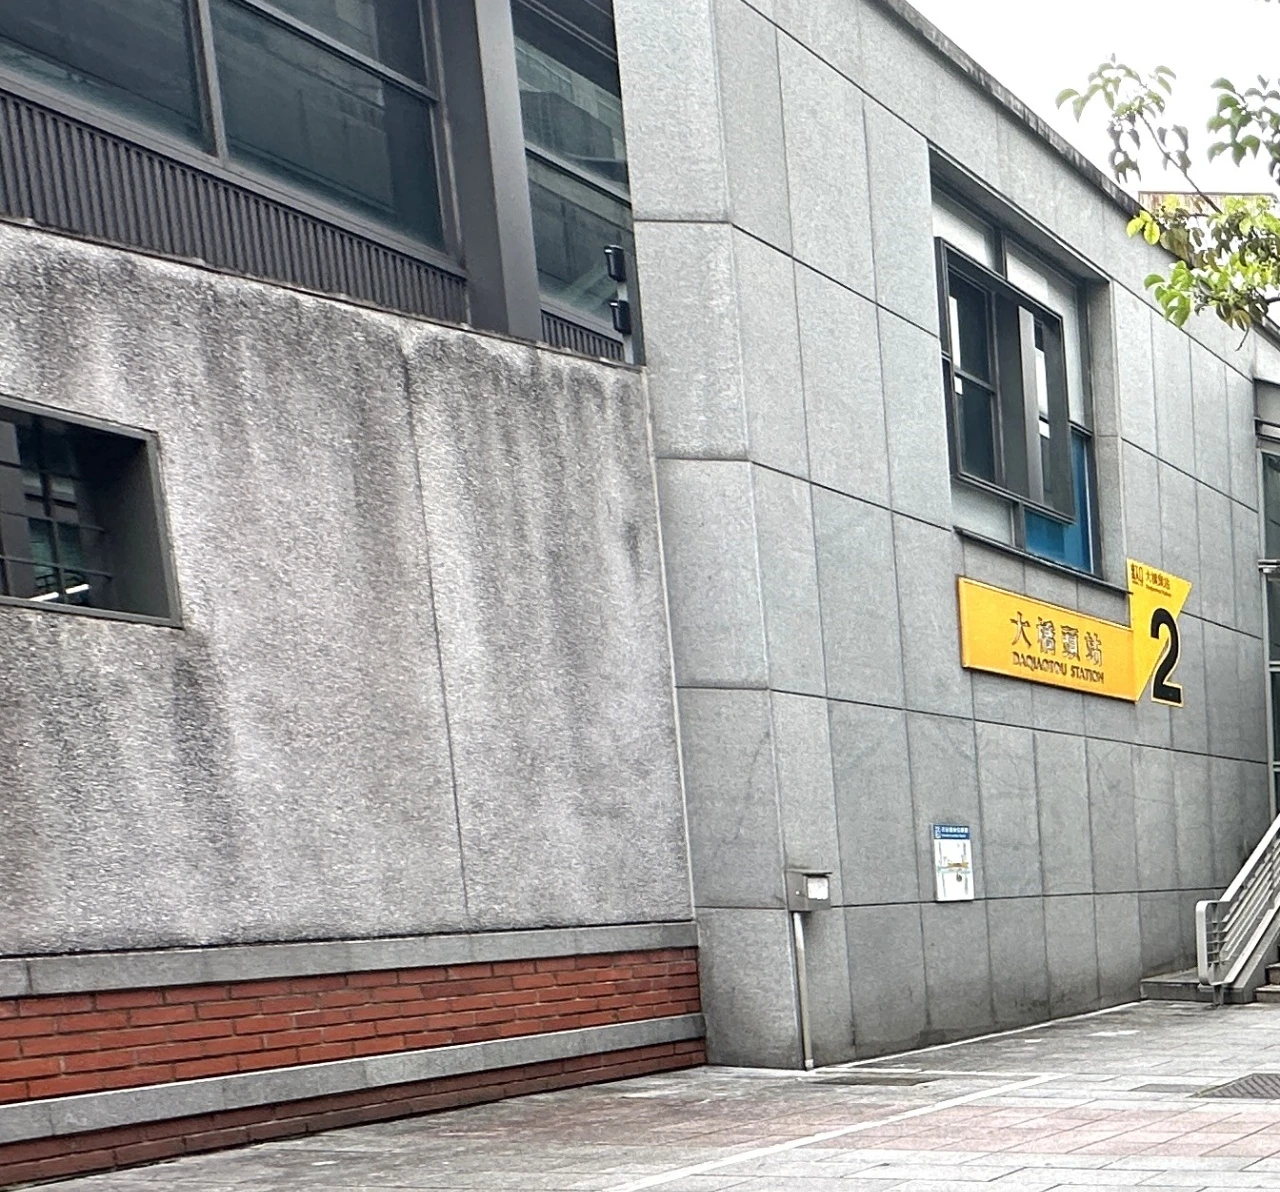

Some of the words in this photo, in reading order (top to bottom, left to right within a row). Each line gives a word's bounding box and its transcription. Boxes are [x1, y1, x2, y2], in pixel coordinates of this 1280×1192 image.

[1010, 611, 1102, 667] 大橋頭站
[1150, 608, 1182, 705] 2
[1012, 651, 1067, 676] DAQIAOTOU
[1071, 665, 1104, 684] STATION
